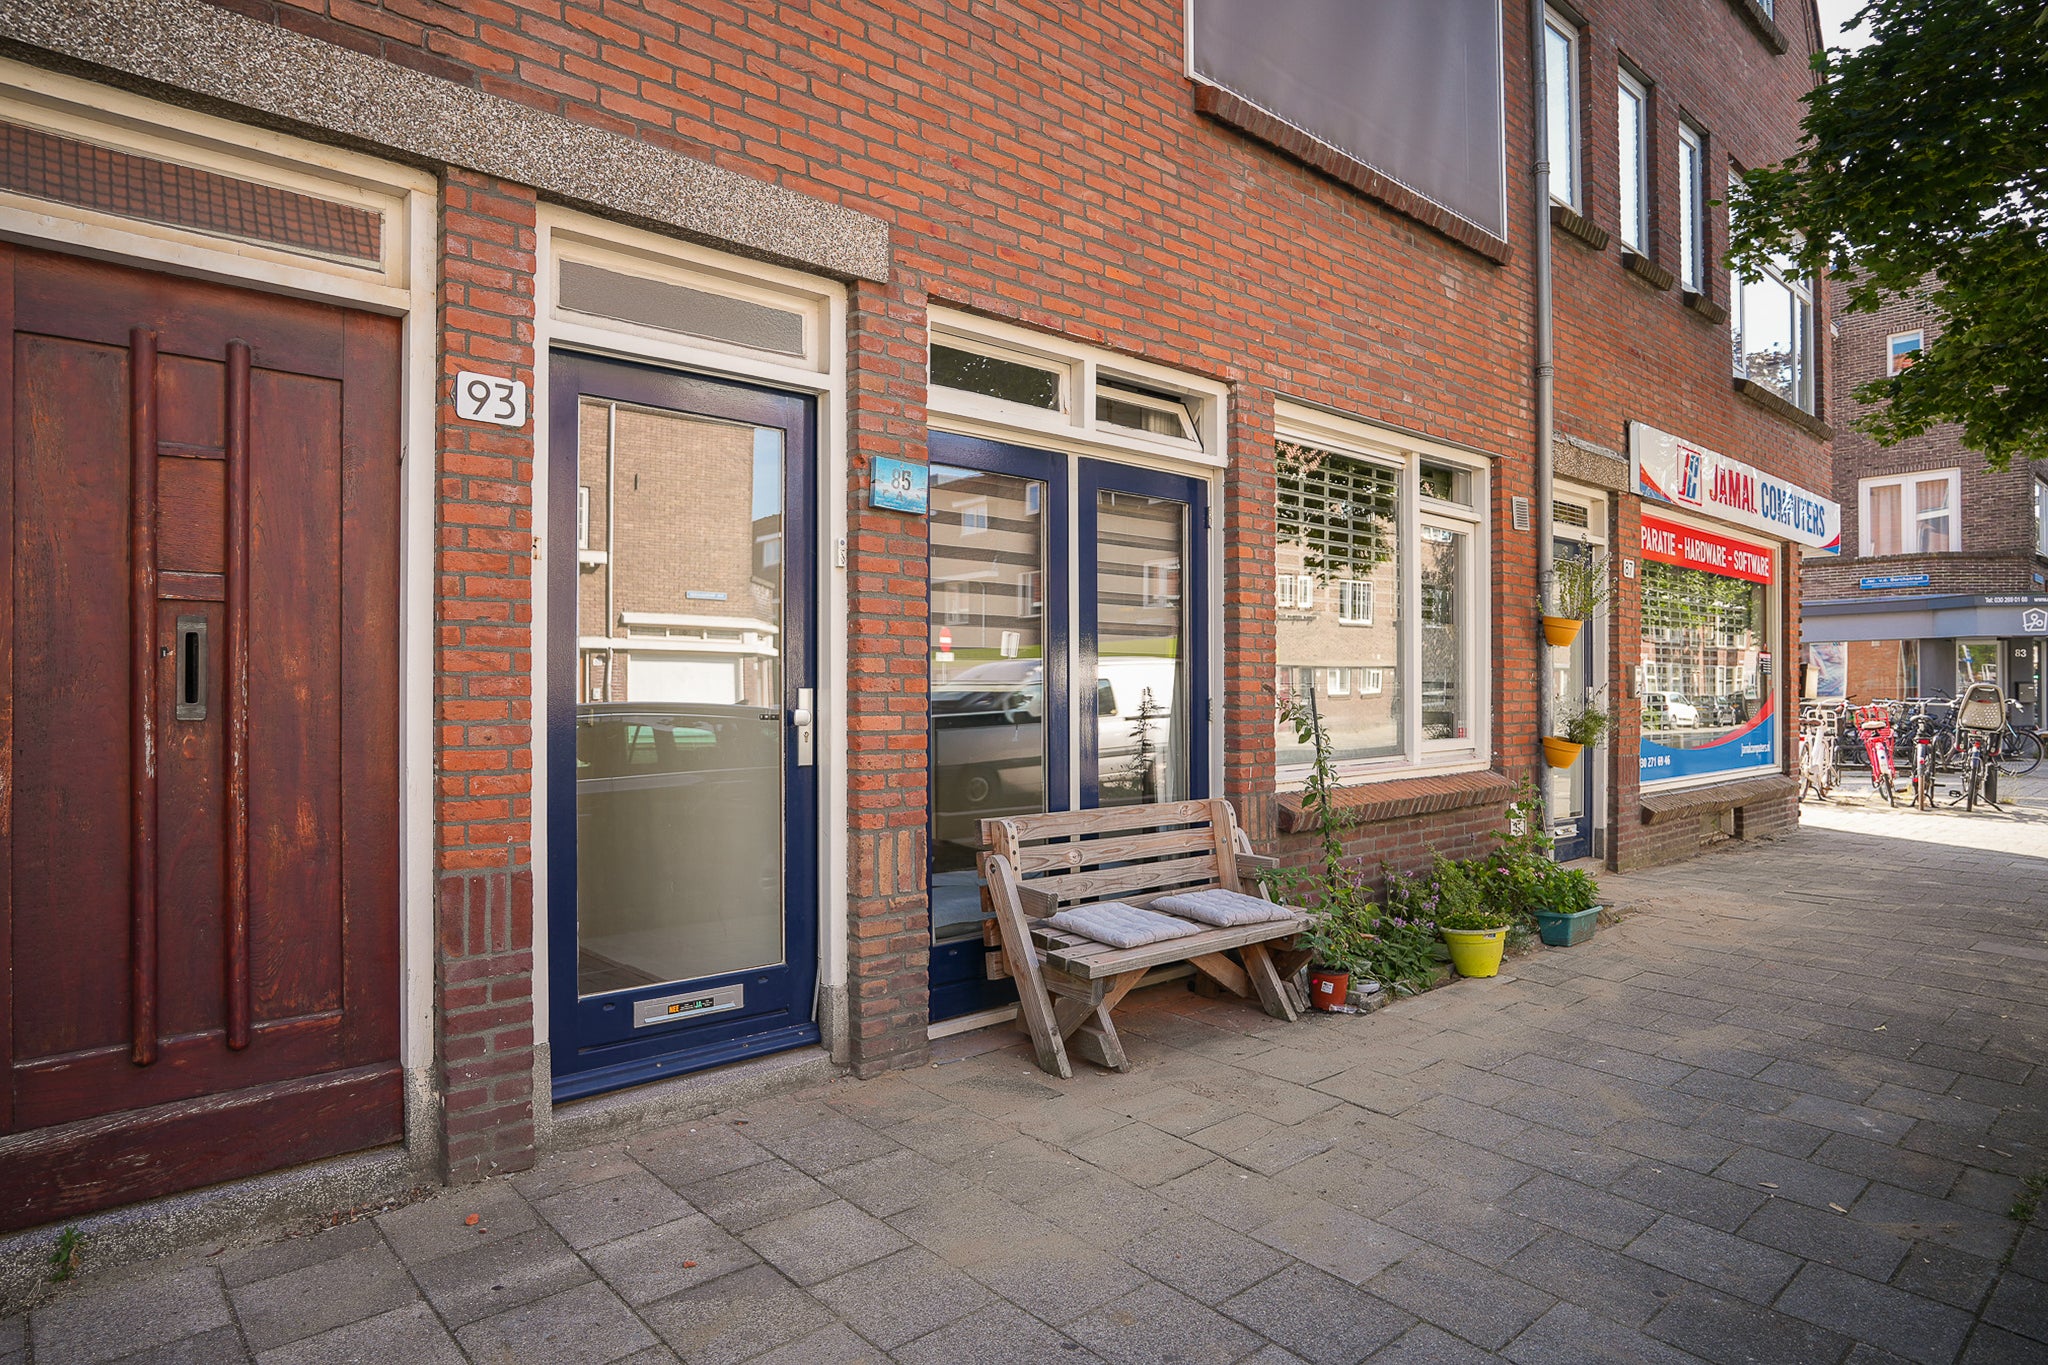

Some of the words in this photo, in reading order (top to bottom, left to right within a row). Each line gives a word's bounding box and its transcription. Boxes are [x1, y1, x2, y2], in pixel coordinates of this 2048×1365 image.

[467, 380, 516, 420] 93
[891, 468, 912, 491] 85
[1709, 463, 1758, 514] JAMAL
[1761, 482, 1825, 538] COMPUTERS
[1641, 525, 1676, 556] PARATIE
[1684, 536, 1727, 568] HARDWARE
[1733, 550, 1769, 577] SOFTWARE
[2014, 648, 2027, 658] 83
